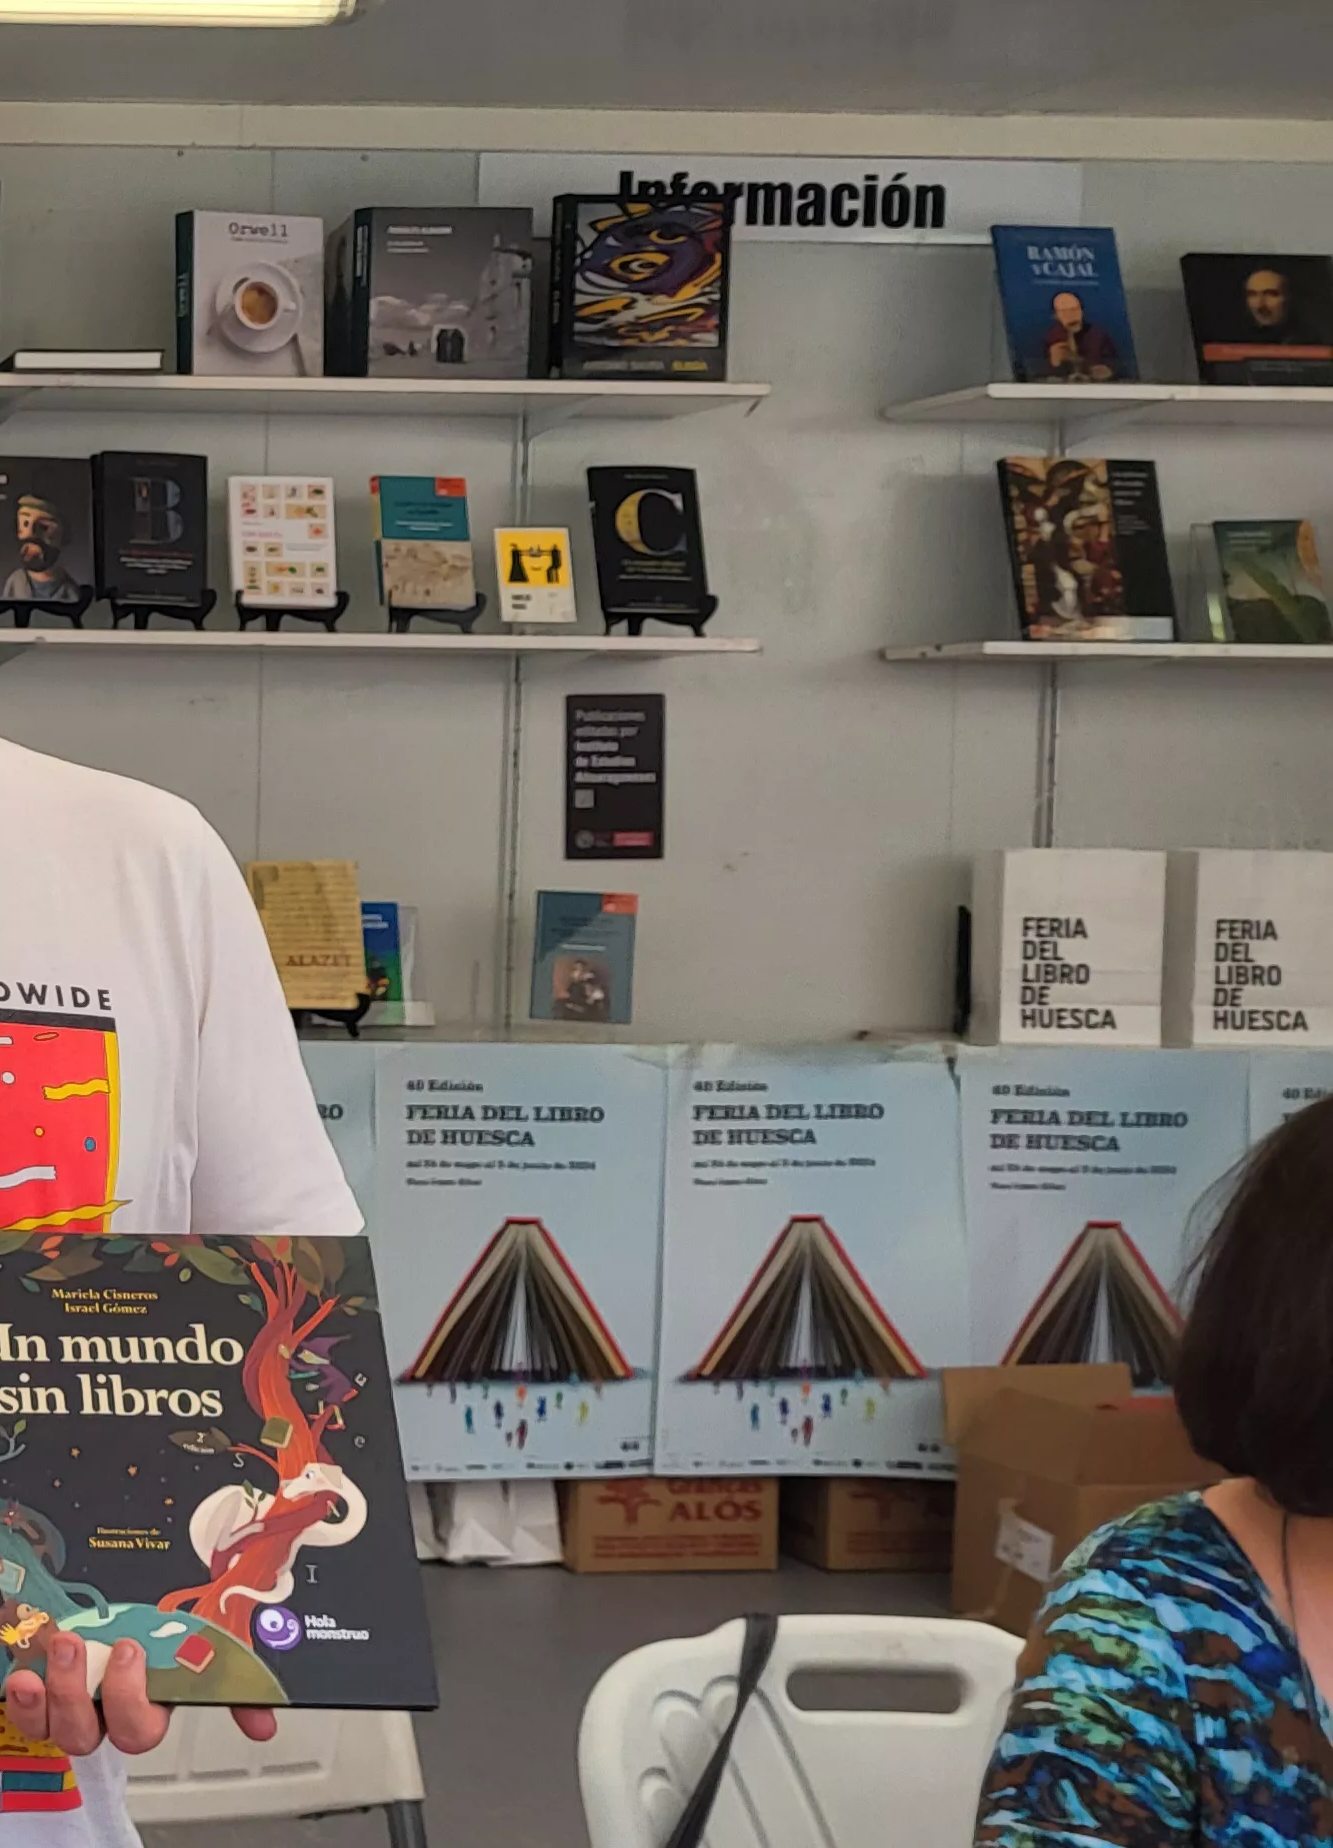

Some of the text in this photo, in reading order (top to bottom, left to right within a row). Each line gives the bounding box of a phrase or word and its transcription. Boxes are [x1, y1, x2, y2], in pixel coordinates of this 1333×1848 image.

[619, 170, 946, 229] rmación
[229, 222, 289, 238] Orwell
[615, 488, 687, 556] C
[1021, 917, 1088, 939] FERIA
[1215, 919, 1279, 941] FERIA
[1021, 940, 1064, 962] DEL
[1215, 943, 1255, 963] DEL
[1021, 963, 1091, 985] LIBRO
[1214, 965, 1282, 987] LIBRO
[1021, 986, 1051, 1006] DE
[1213, 987, 1242, 1008] DE
[1020, 1008, 1117, 1030] HUESCA
[1212, 1010, 1309, 1032] HUESCA
[428, 1079, 483, 1093] Edición
[406, 1104, 605, 1123] FERIA DEL LIBRO
[692, 1102, 885, 1121] FERIA DEL LIBRO
[989, 1108, 1189, 1128] FERIA DEL LIBRO
[406, 1129, 536, 1147] DE HUESCA
[692, 1128, 817, 1145] DE HUESCA
[989, 1133, 1121, 1151] DE HUESCA
[52, 1288, 159, 1301] Mariela Cisneros
[64, 1302, 148, 1315] Israel Gómez
[58, 1323, 244, 1366] mundo
[76, 1373, 224, 1417] libros
[88, 1536, 171, 1551] Susana Vivar
[304, 1614, 337, 1628] Hola
[306, 1628, 370, 1641] monstruo
